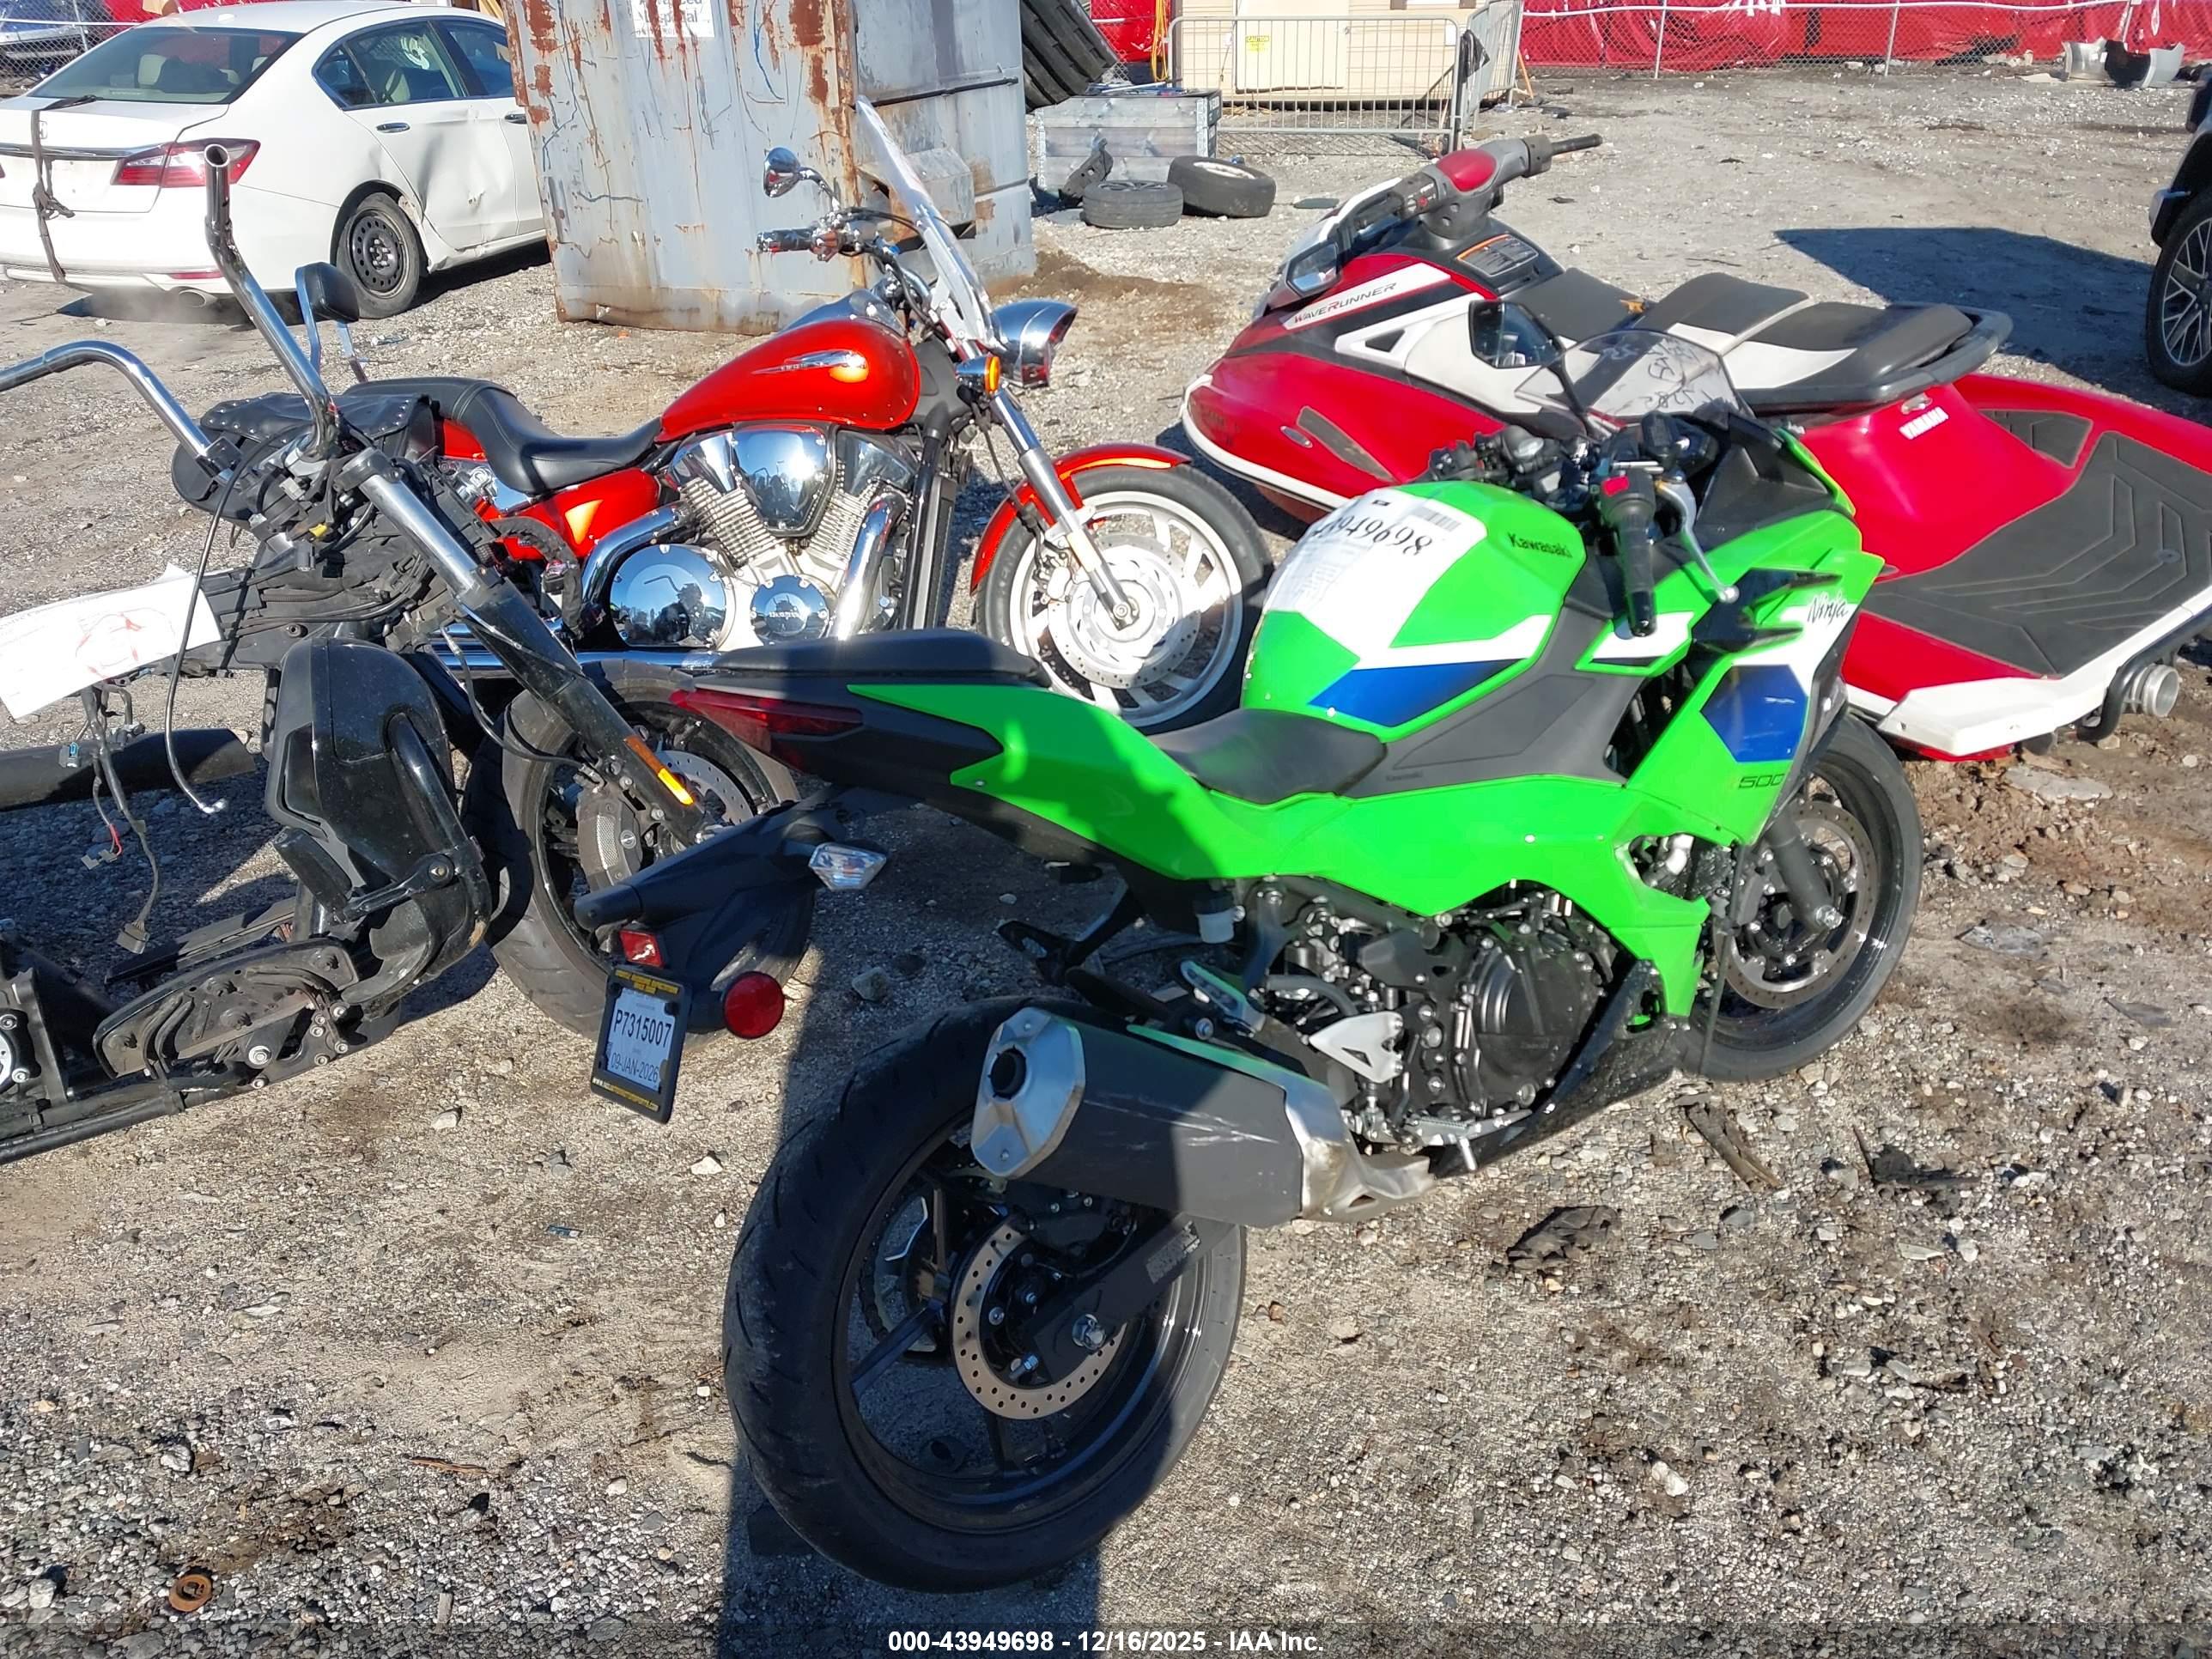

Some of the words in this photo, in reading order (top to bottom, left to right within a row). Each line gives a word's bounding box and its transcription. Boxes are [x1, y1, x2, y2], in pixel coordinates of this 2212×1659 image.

[1294, 283, 1397, 324] WAVERUNNER
[1899, 406, 1949, 440] YAMAHA
[1507, 531, 1573, 558] Kawasaki
[1808, 591, 1850, 627] Ninja
[1738, 773, 1785, 789] 500
[613, 1009, 672, 1048] P7315007
[611, 1052, 659, 1084] 09-JAN-2026
